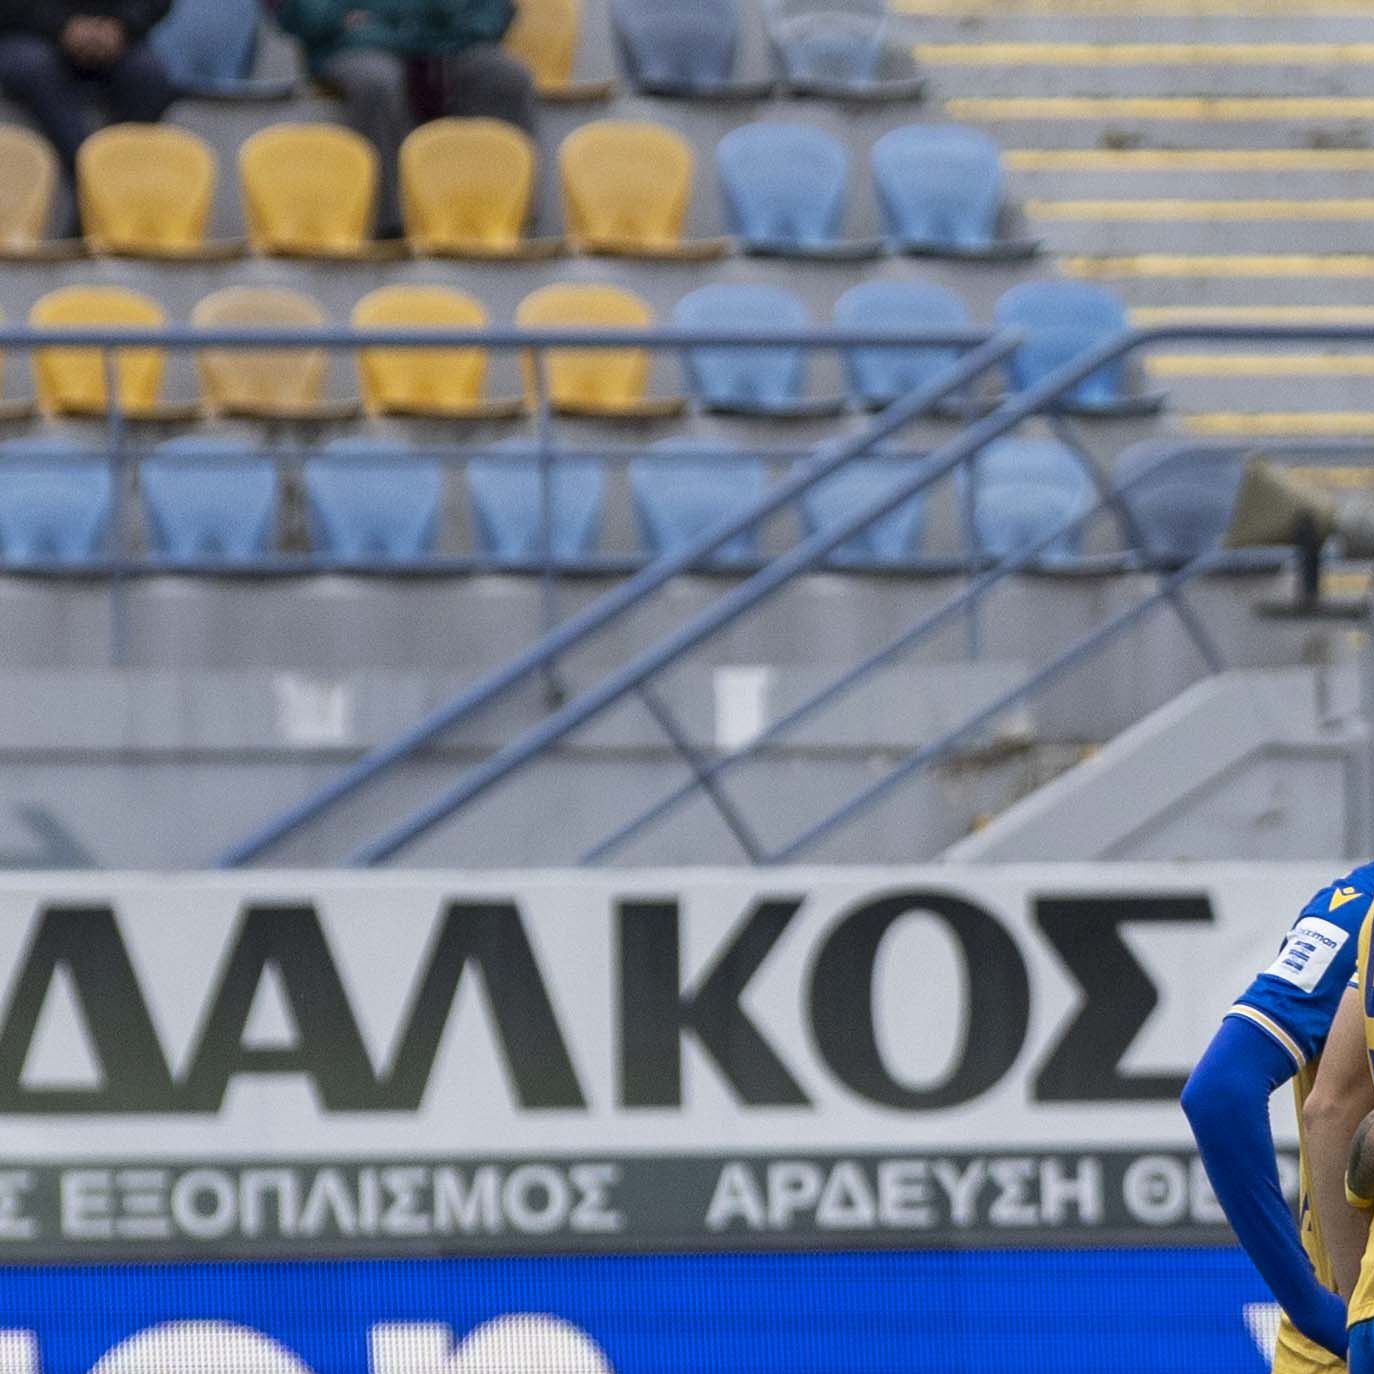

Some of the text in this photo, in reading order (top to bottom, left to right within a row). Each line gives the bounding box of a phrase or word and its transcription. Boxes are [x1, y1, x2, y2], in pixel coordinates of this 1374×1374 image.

[0, 887, 1215, 1113] ΔΑΛΚΟΣ
[60, 1163, 623, 1238] ΕΞΟΠΛΙΣΜΟΣ
[704, 1158, 1101, 1231] ΑΡΔΕΥΣΗ
